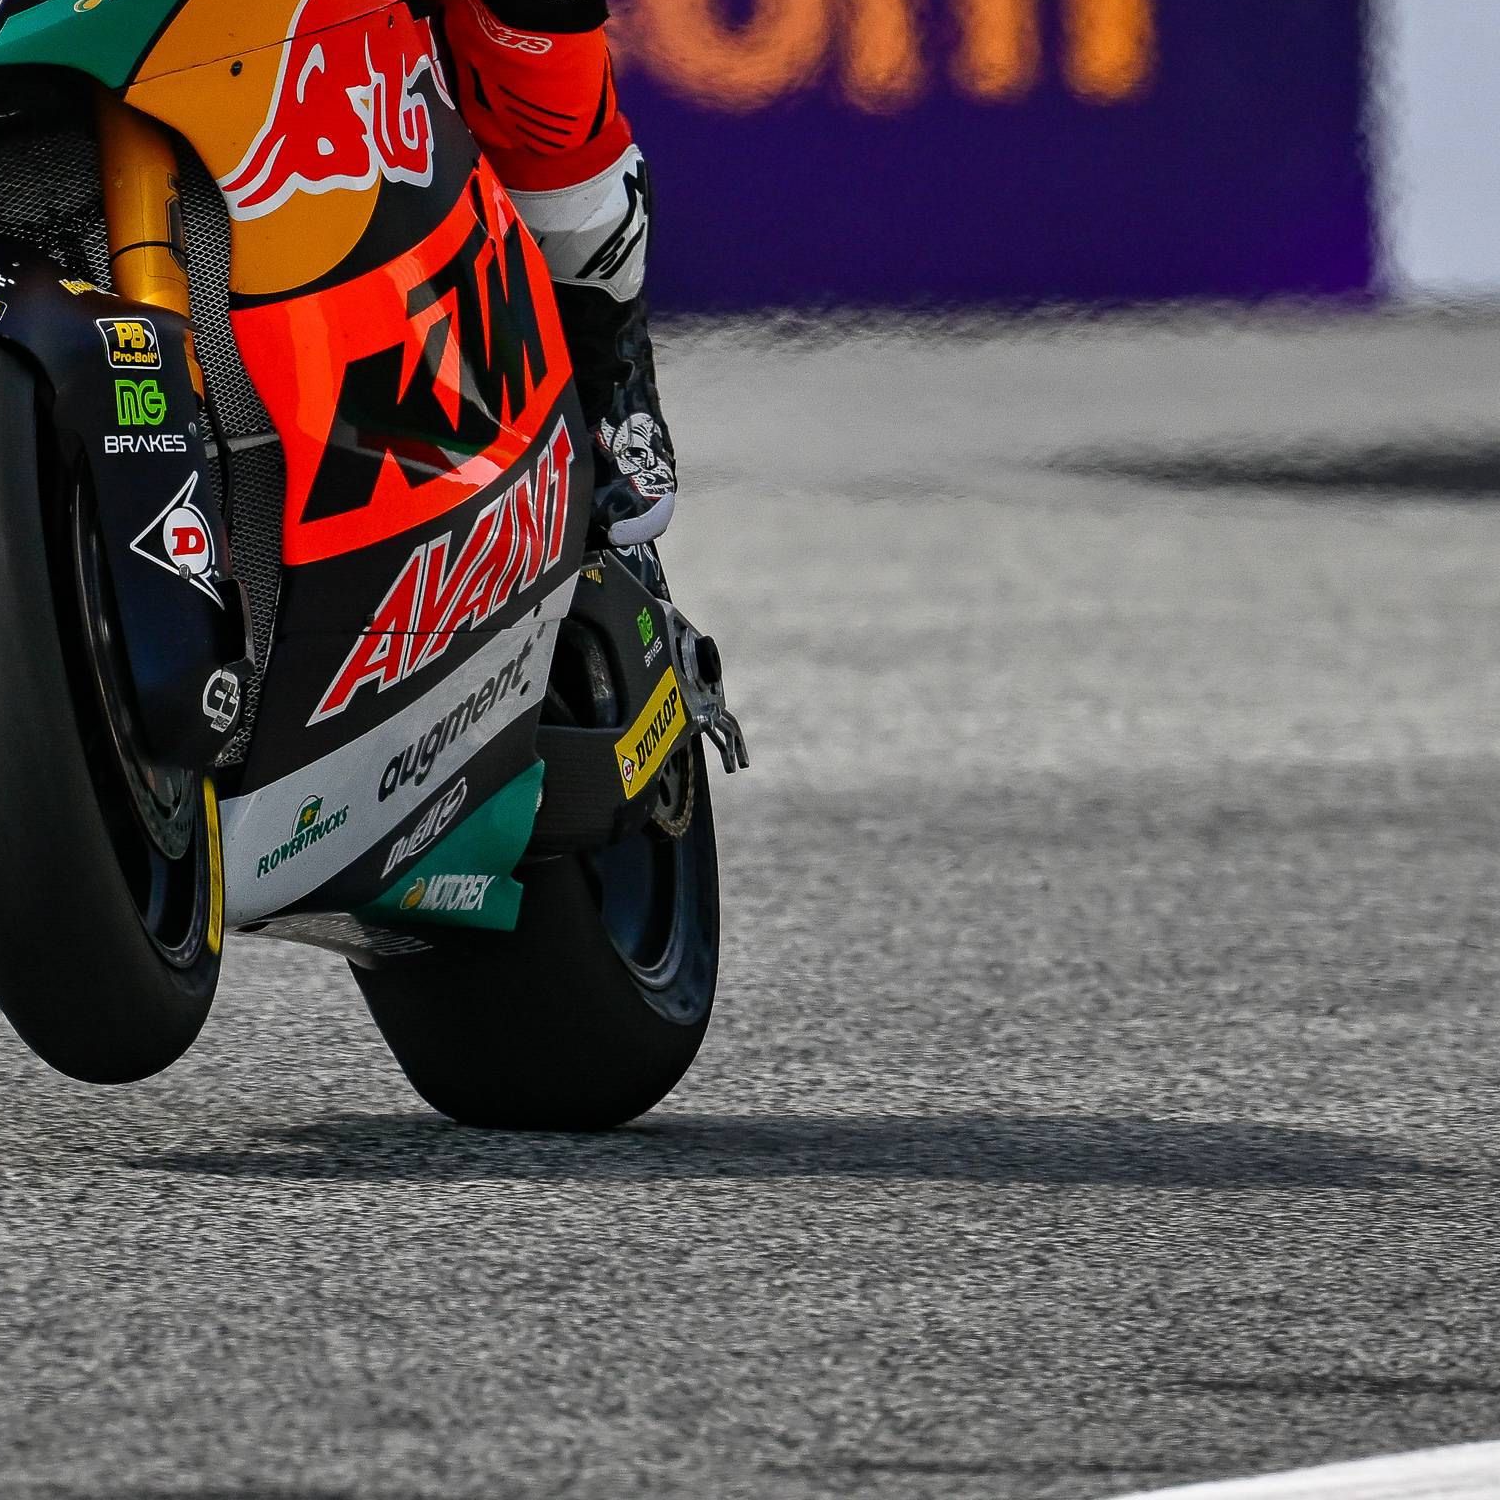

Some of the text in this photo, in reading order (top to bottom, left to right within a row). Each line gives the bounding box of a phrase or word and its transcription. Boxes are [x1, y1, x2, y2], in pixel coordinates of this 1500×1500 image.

[113, 322, 146, 349] PB
[113, 350, 155, 364] Pro-Bolt
[300, 215, 548, 524] KTM
[103, 434, 187, 454] BRAKES
[172, 525, 207, 556] D
[304, 413, 574, 729] AVANT
[378, 635, 534, 803] augment
[635, 684, 678, 772] DUNLOP
[256, 803, 350, 880] FLOWERTRUCKS
[417, 874, 496, 911] MOTOREX
